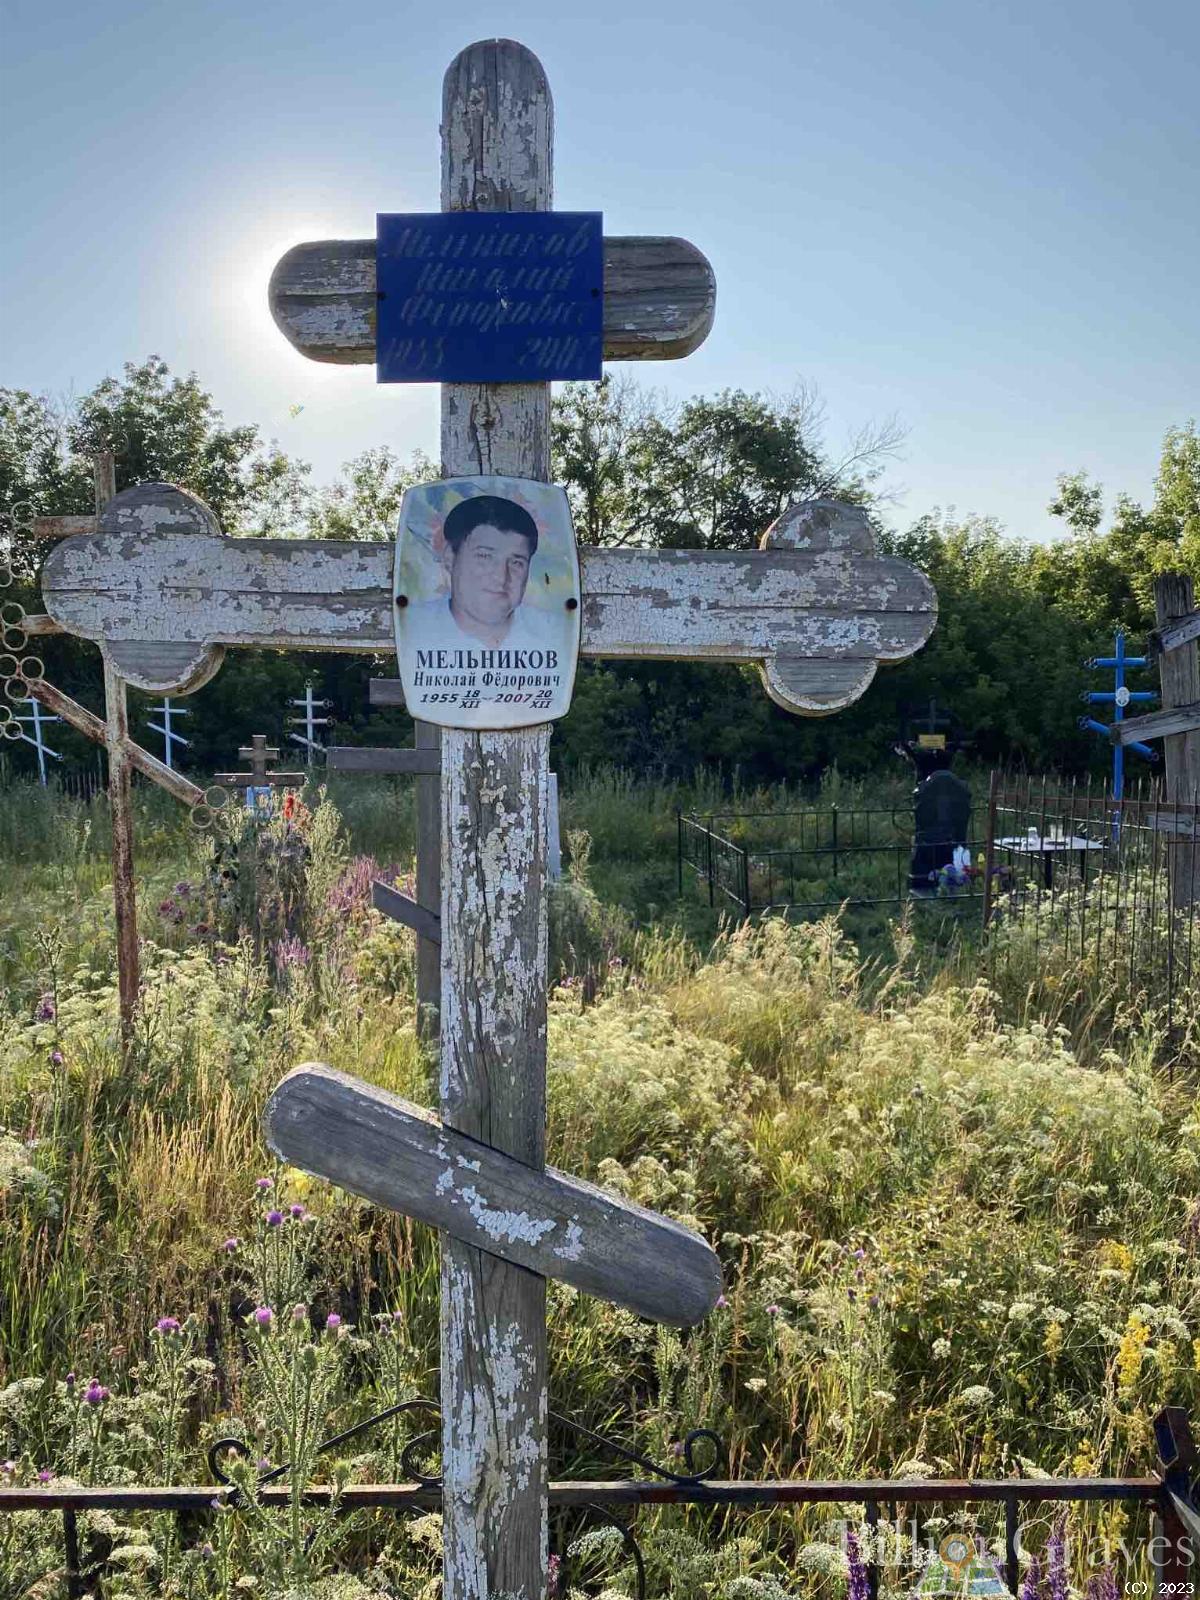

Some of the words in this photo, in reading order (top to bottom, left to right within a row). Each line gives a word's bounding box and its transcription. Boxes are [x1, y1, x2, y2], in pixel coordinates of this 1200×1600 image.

[416, 650, 558, 669] МЕЛЬНИКОВ
[413, 671, 476, 687] Николай
[482, 671, 560, 690] Фёдорович
[420, 693, 459, 703] 1955
[464, 690, 480, 698] 18
[494, 693, 532, 703] 2007
[536, 690, 553, 698] 20
